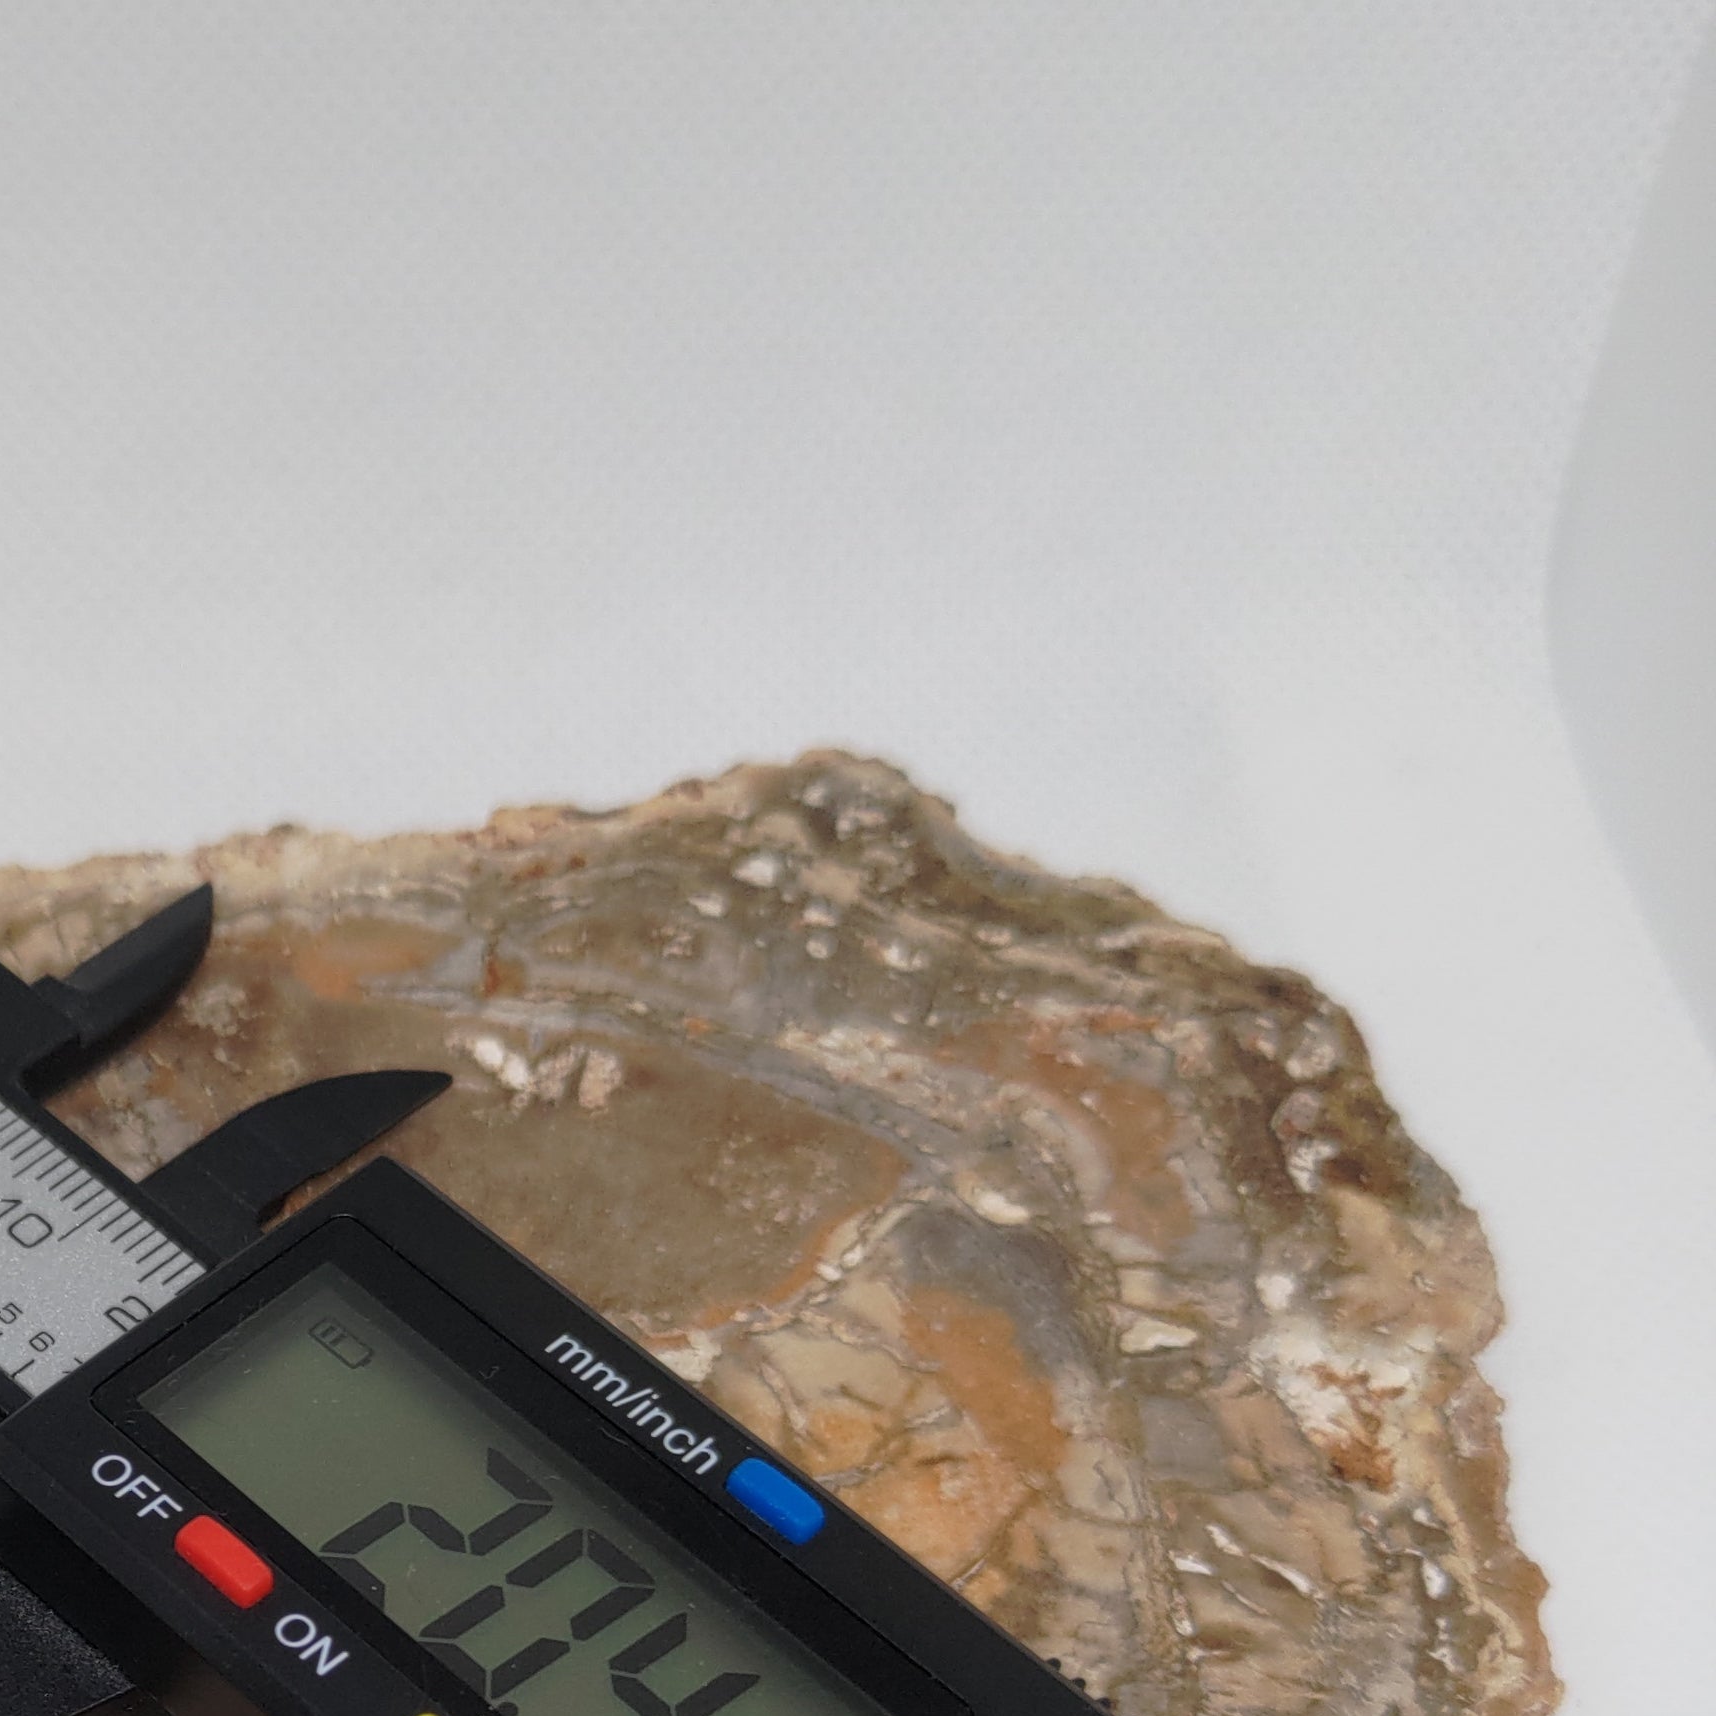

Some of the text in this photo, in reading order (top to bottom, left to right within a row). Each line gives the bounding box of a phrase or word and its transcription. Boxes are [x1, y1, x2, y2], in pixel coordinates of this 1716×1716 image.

[28, 1331, 56, 1352] 6
[543, 1333, 720, 1476] mm/inch
[91, 1454, 184, 1520] OFF
[274, 1613, 350, 1677] ON
